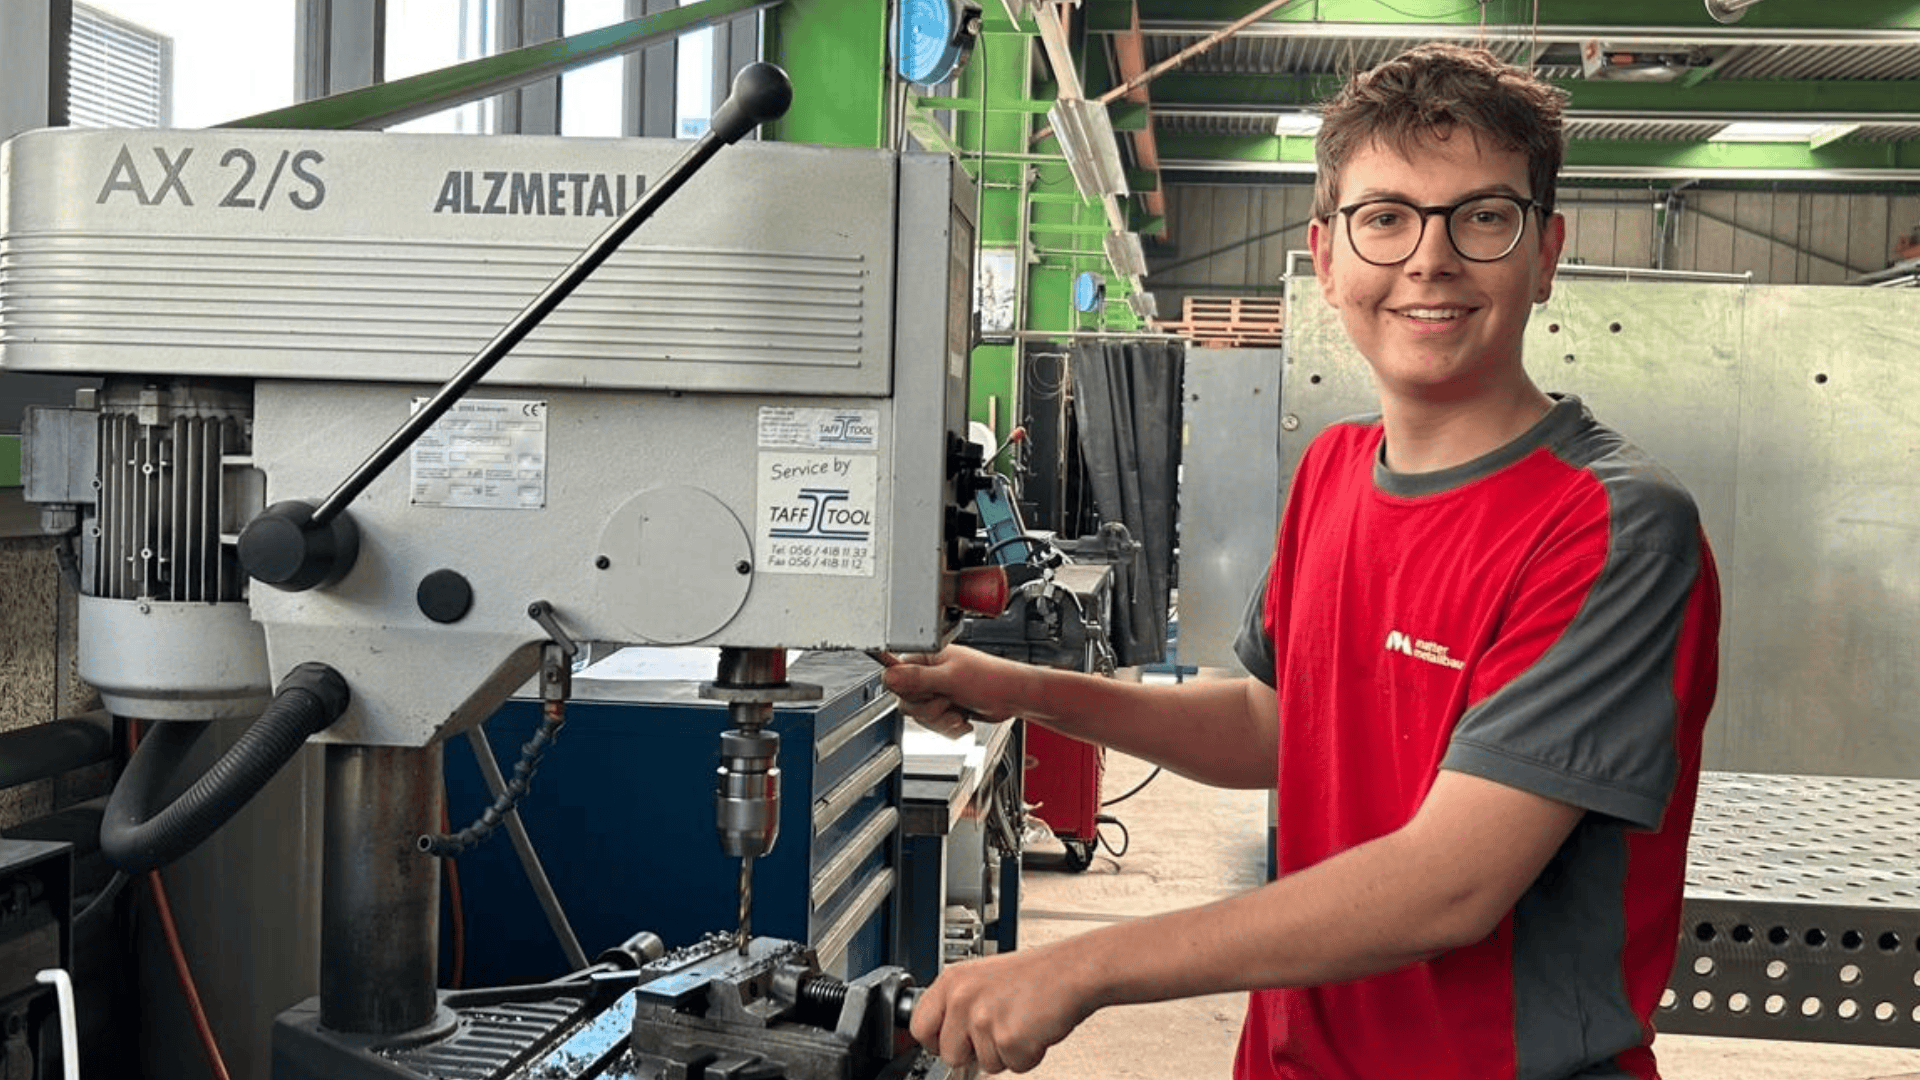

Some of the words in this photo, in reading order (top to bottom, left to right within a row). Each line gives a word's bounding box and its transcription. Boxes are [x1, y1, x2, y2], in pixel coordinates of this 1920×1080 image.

[96, 142, 195, 207] AX
[218, 147, 326, 212] 2/S
[820, 423, 841, 435] TAFF
[850, 424, 874, 436] TOOL
[771, 460, 829, 481] Service
[833, 457, 852, 477] by
[769, 506, 809, 523] TAFF
[827, 508, 872, 526] TOOL
[789, 545, 812, 557] 056
[788, 557, 812, 567] 056
